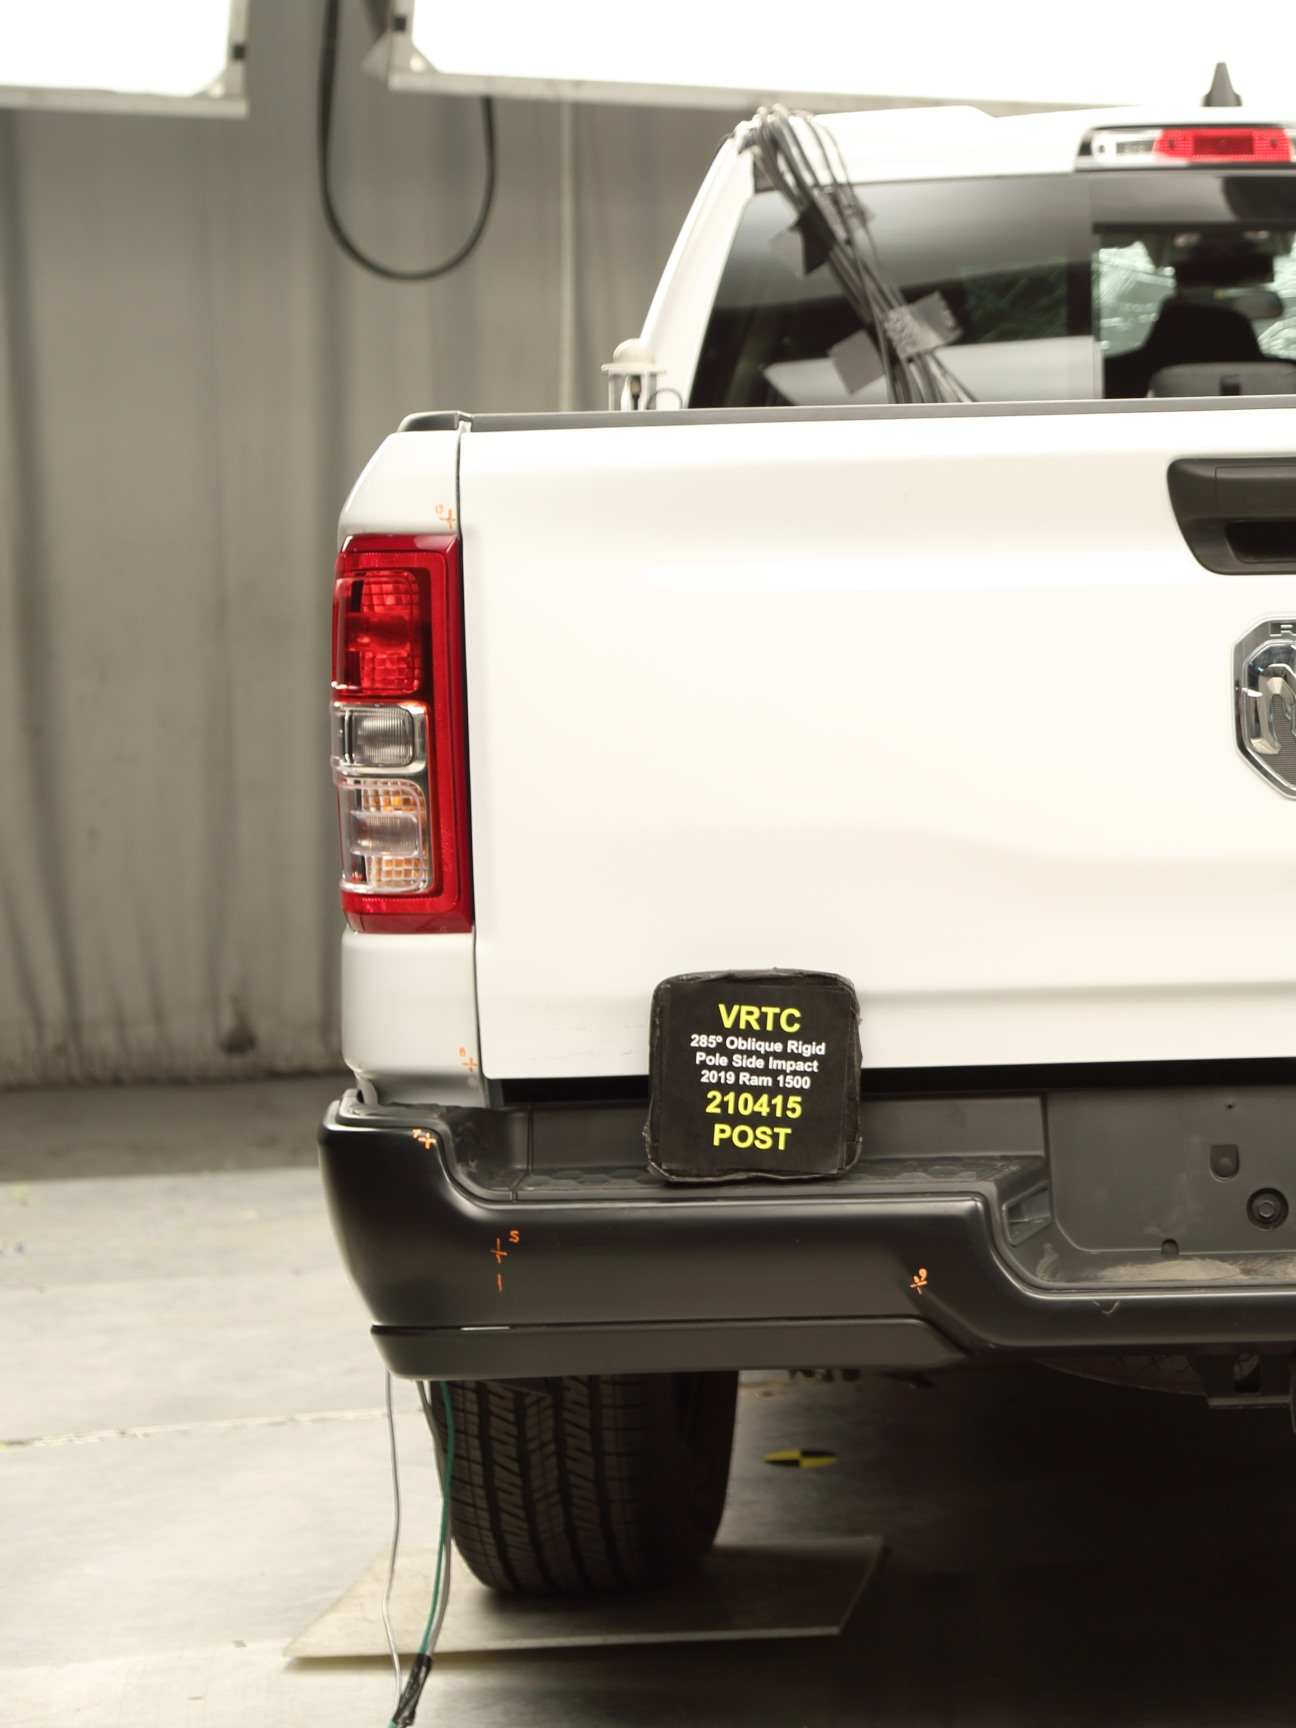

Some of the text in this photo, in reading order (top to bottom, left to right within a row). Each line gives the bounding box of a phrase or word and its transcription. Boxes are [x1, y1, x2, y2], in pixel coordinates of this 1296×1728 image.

[718, 1003, 802, 1033] VRTC
[725, 1035, 783, 1054] Oblique
[787, 1040, 826, 1057] Rigid
[695, 1051, 819, 1073] Pole Side Impact
[700, 1069, 811, 1089] 2019 Ram 1500
[705, 1090, 803, 1119] 210415
[712, 1123, 793, 1151] POST
